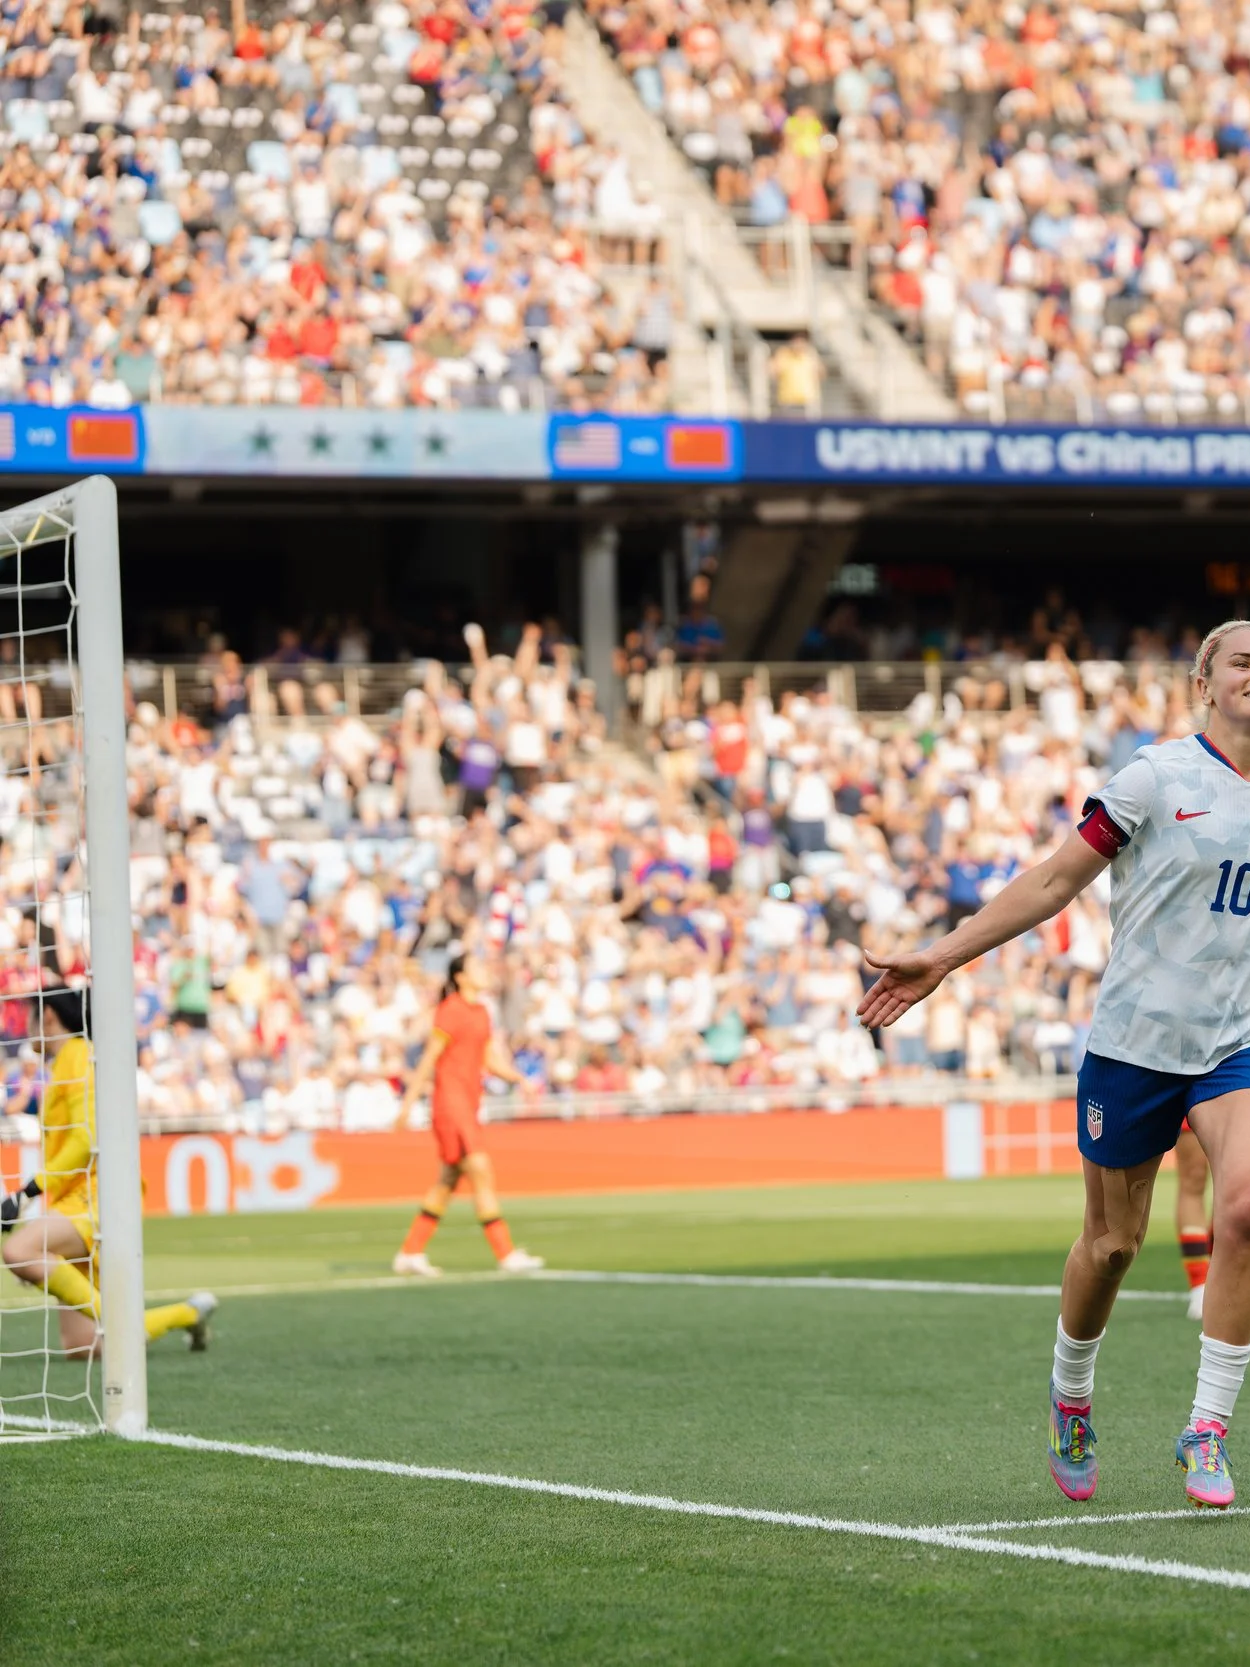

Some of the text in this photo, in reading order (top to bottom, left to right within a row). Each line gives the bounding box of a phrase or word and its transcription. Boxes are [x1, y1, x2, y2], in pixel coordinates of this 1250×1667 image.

[816, 428, 993, 471] USWNT
[996, 434, 1053, 473] vs
[1057, 431, 1192, 475] China
[1089, 1107, 1102, 1123] USA
